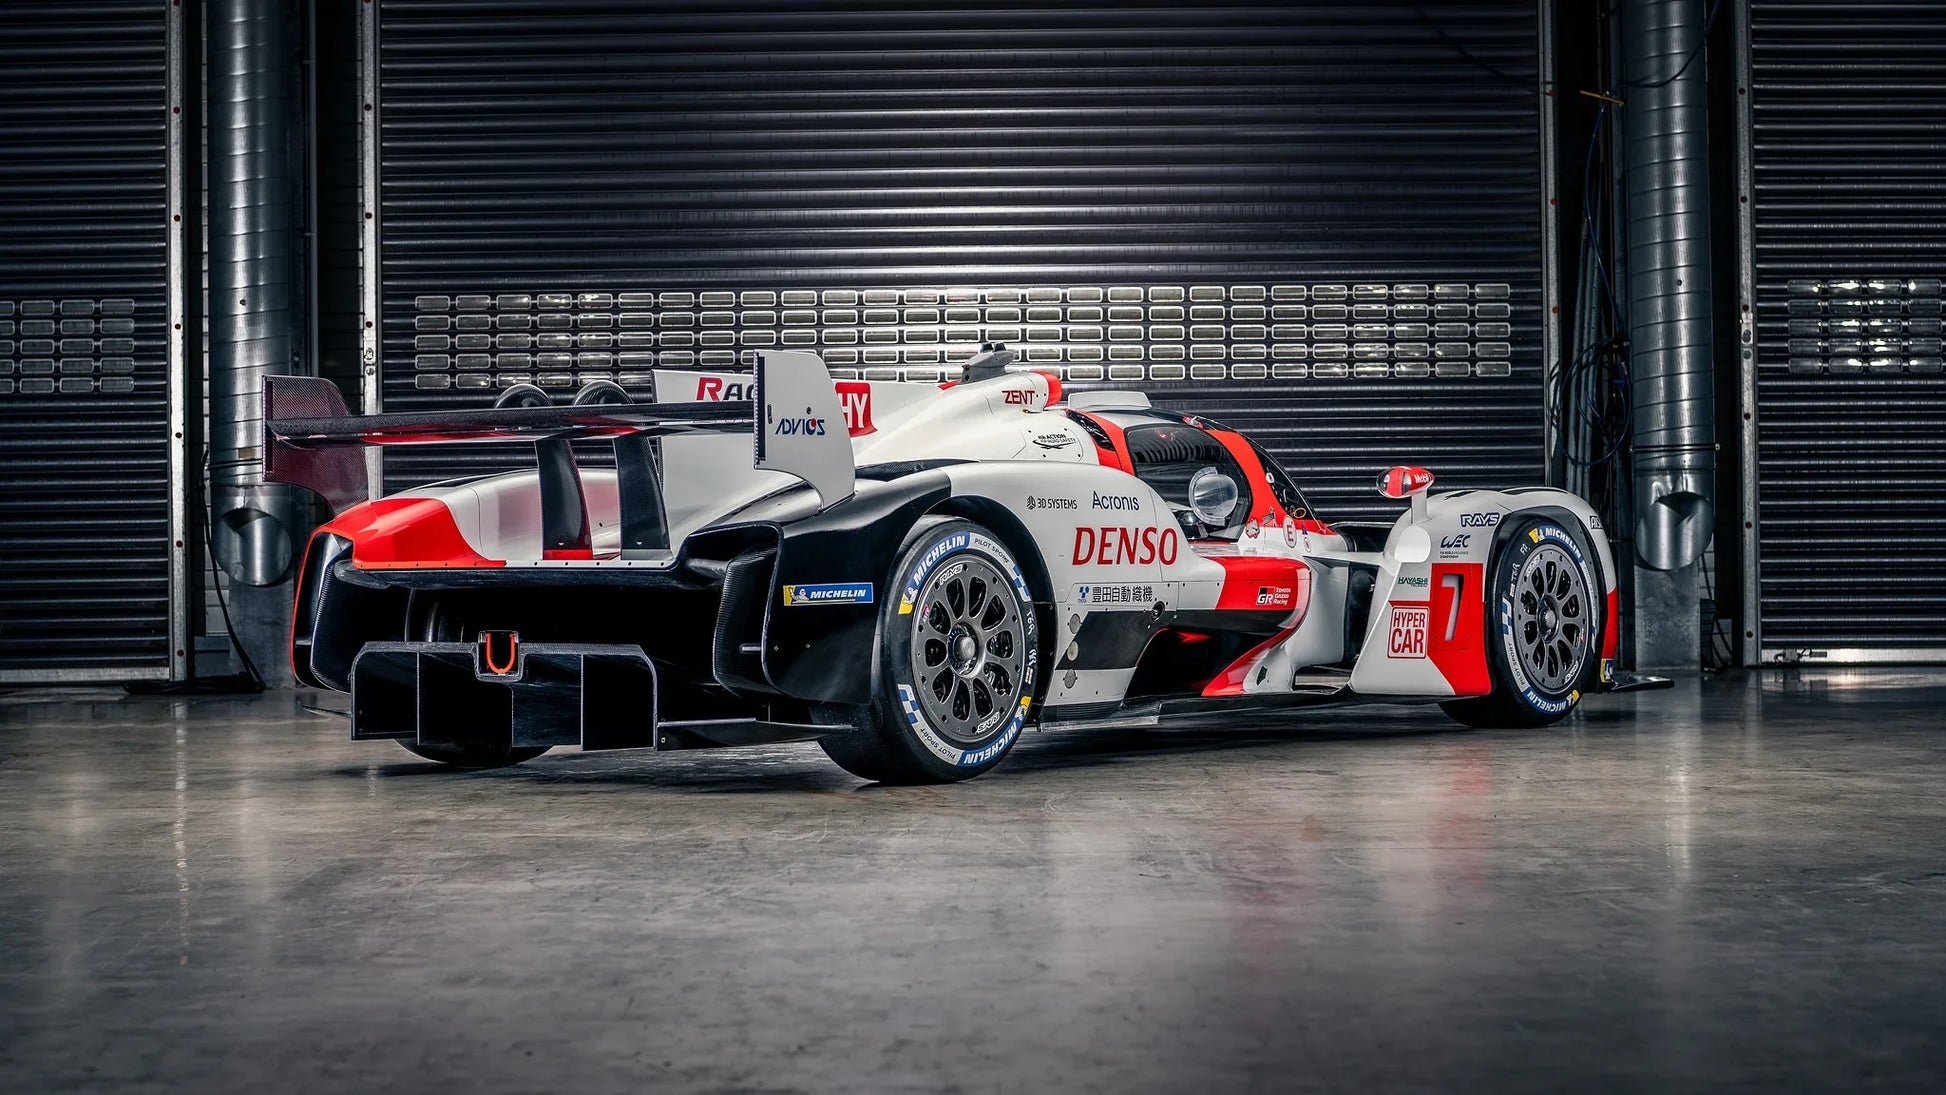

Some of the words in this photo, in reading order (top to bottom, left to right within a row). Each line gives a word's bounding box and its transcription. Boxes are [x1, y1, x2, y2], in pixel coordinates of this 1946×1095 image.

[1001, 390, 1035, 404] ZENT
[838, 393, 868, 428] HY
[1037, 498, 1047, 509] 3D
[1048, 498, 1078, 510] SYSTEMS
[1092, 490, 1140, 511] Acronis
[1461, 513, 1499, 527] RAYS
[974, 538, 991, 549] PILOT
[1072, 527, 1179, 566] DENSO
[1440, 534, 1471, 548] WEC
[1545, 527, 1582, 559] MICHELIN
[913, 535, 965, 587] MICHELIN
[810, 589, 866, 599] MICHELIN
[1257, 594, 1273, 604] GR
[1442, 573, 1464, 641] 7
[1393, 612, 1426, 628] HYPER
[1391, 628, 1424, 653] CAR
[1527, 690, 1567, 712] MICHELIN
[920, 727, 940, 748] SPORT
[963, 720, 1017, 764] MICHELIN
[939, 747, 956, 760] PILOT
